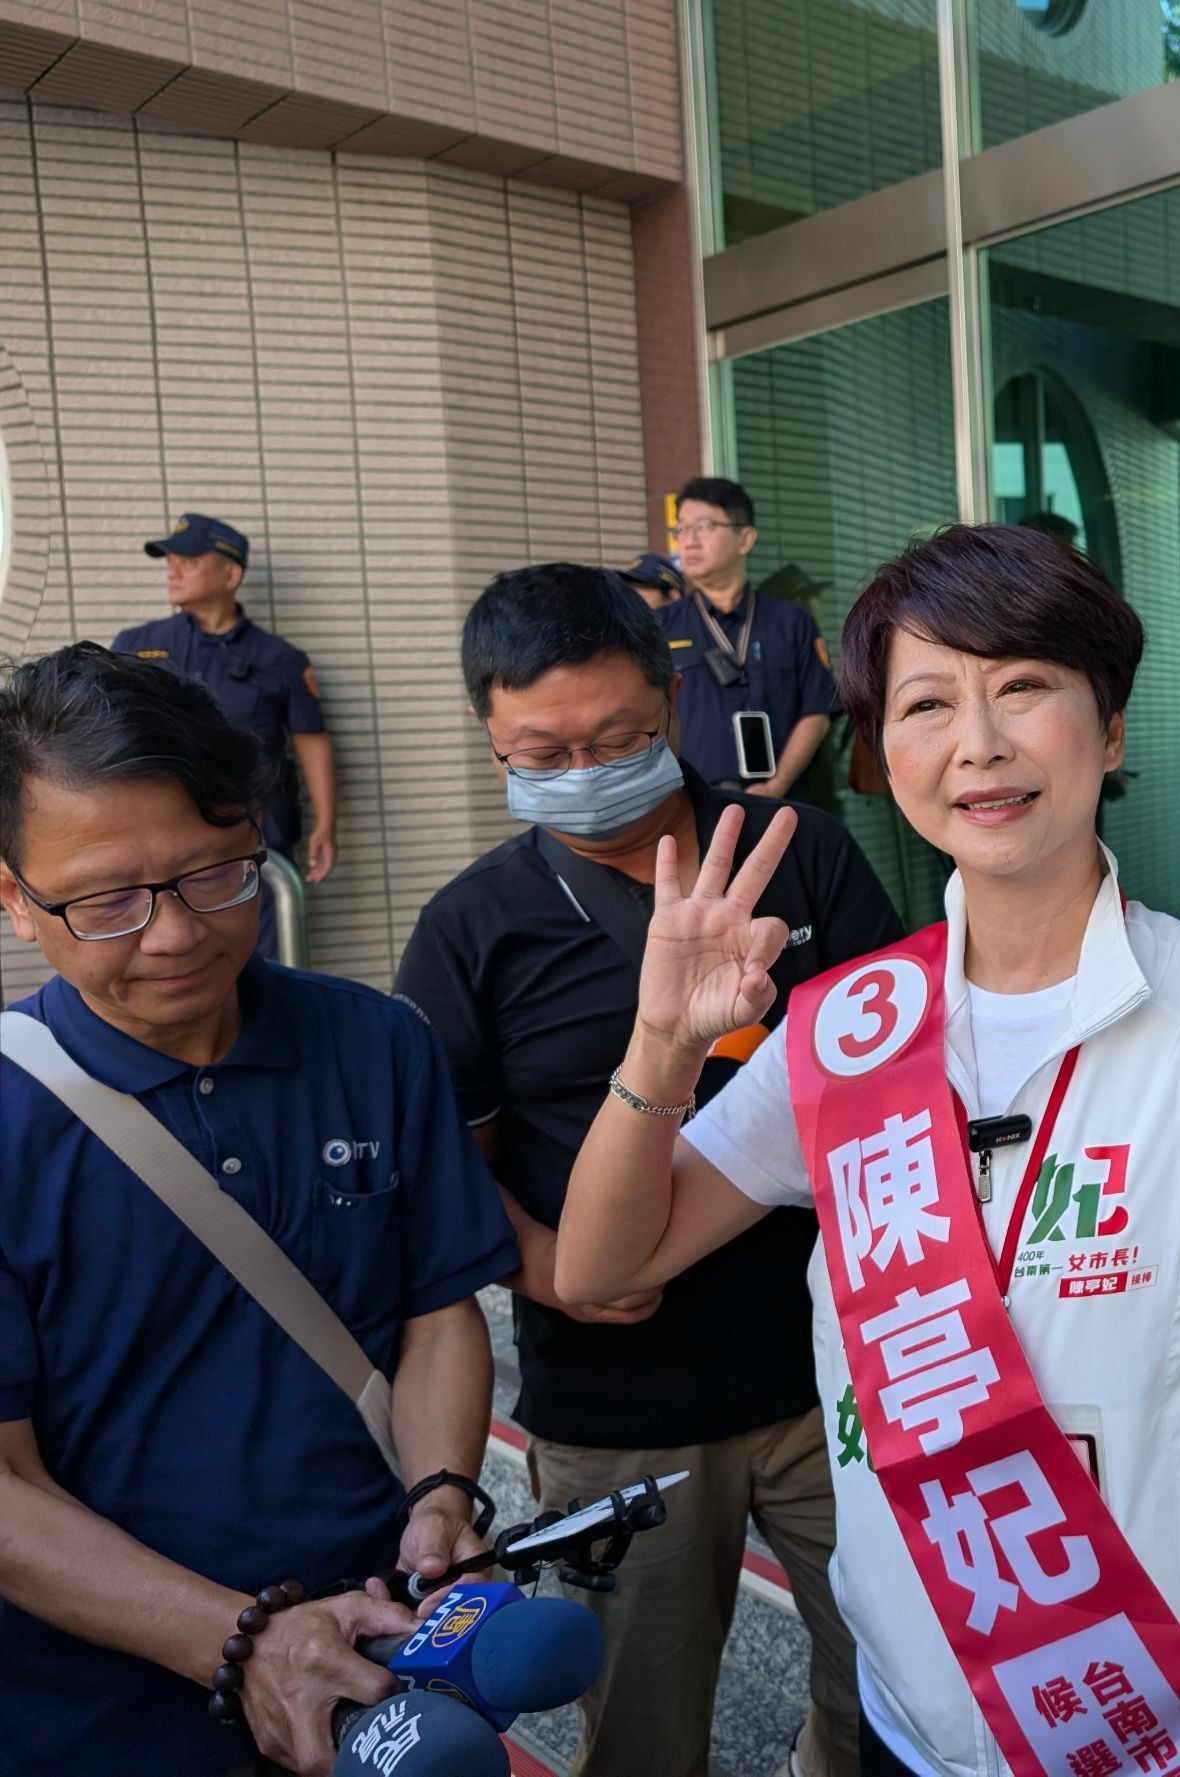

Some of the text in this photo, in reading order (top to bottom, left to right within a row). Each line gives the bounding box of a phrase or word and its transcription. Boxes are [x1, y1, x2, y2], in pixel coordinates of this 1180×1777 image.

[837, 970, 897, 1058] 3
[1017, 1250, 1045, 1262] 400年
[1068, 1276, 1119, 1295] 陳亭妃
[827, 1109, 1101, 1637] 陳亭妃
[403, 1592, 463, 1656] NTD
